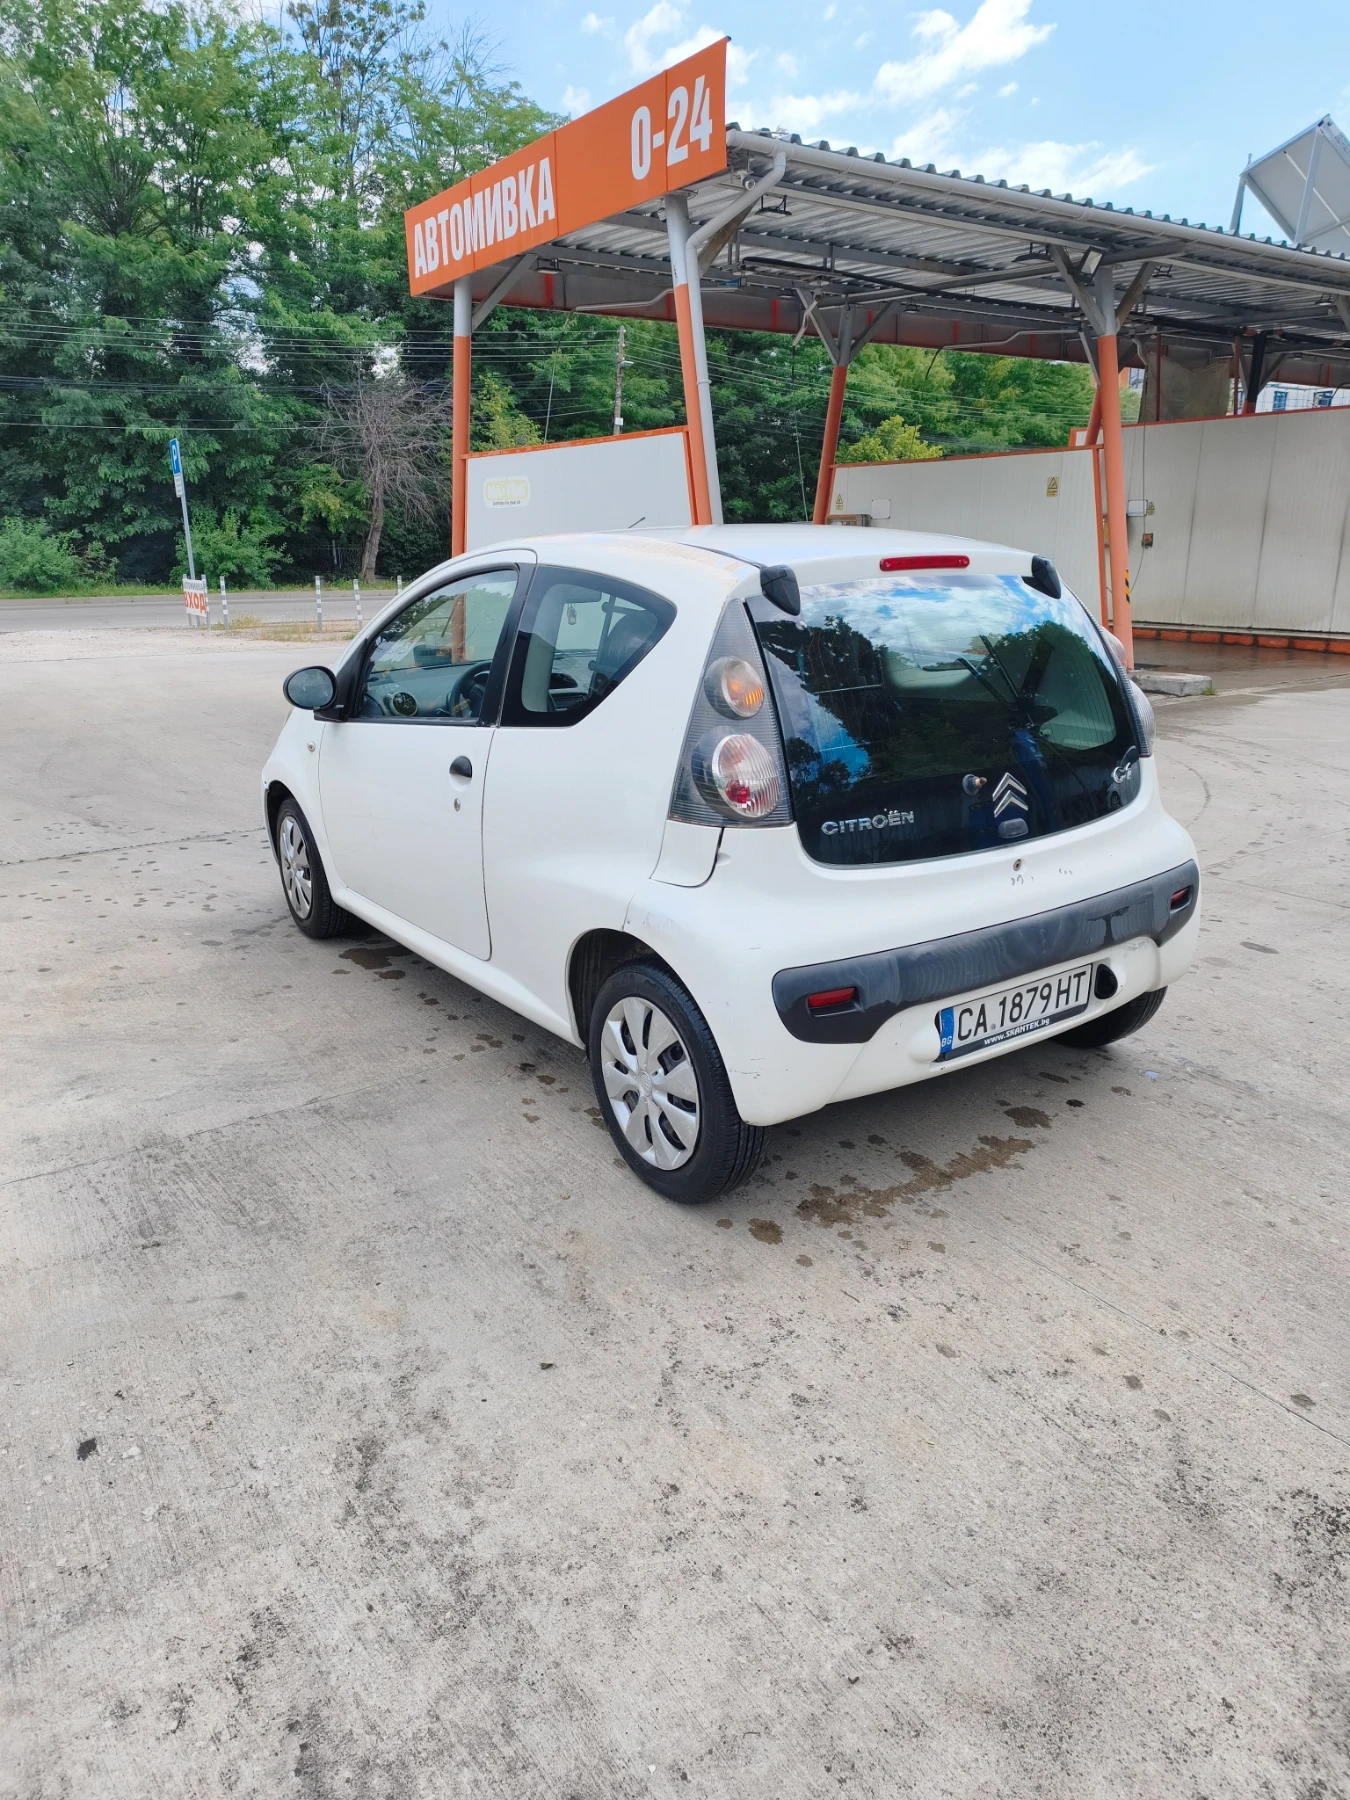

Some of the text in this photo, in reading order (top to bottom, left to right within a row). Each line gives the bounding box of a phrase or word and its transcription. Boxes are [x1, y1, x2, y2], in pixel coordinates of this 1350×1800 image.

[414, 74, 713, 279] АВТОМИВКА 0-24
[821, 810, 915, 836] CITROËN
[941, 1035, 953, 1048] BG
